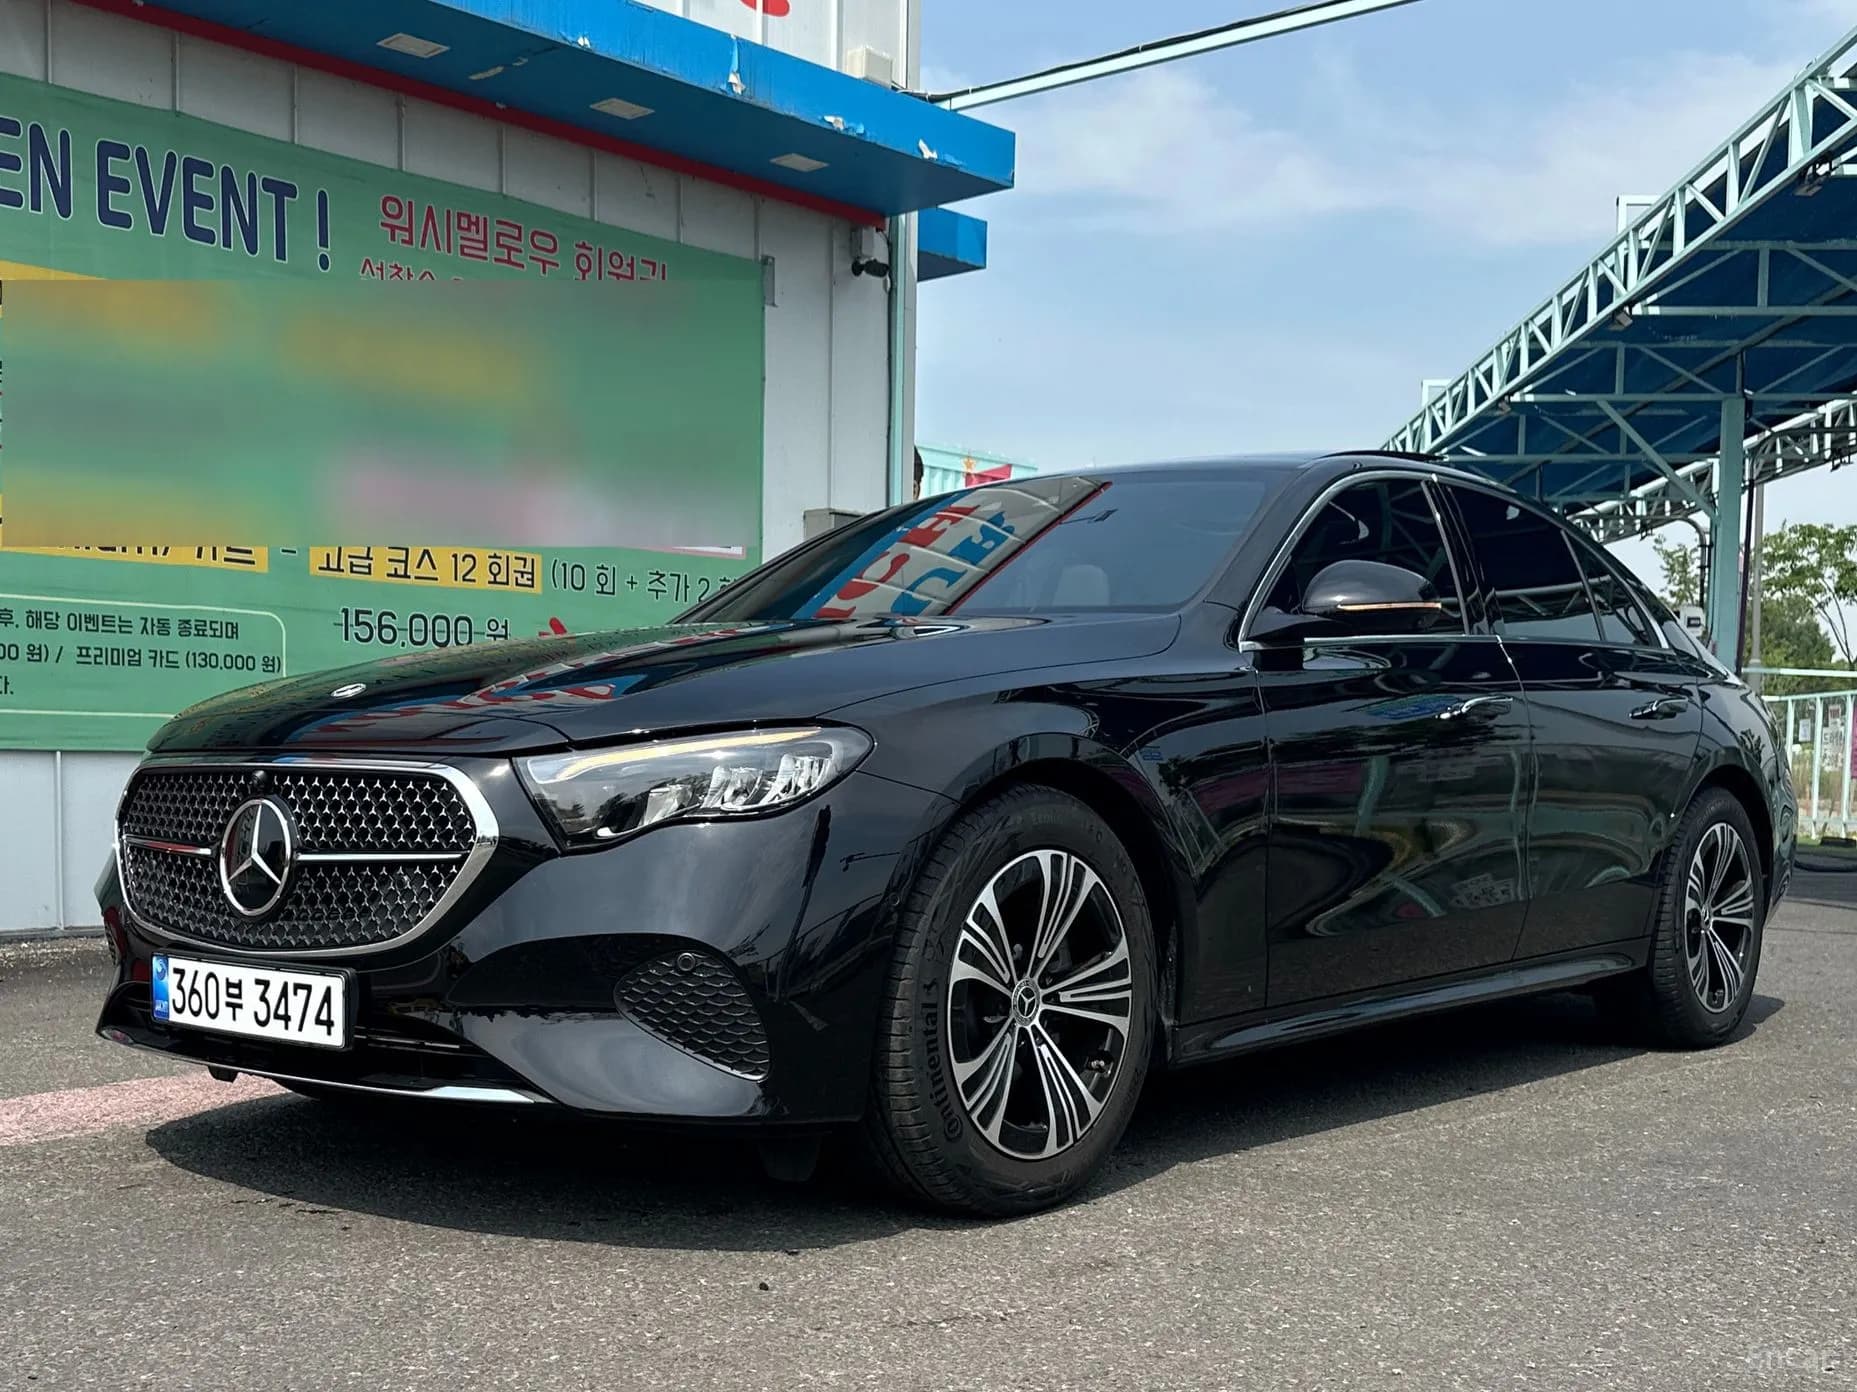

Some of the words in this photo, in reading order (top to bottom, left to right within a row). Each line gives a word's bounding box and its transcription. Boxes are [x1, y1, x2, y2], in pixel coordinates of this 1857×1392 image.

[96, 138, 298, 263] EVENT
[379, 194, 560, 276] 워시멜로우
[318, 546, 374, 577] 고급
[386, 546, 439, 582] 코스
[451, 552, 477, 583] 12
[487, 552, 536, 589] 회권
[551, 558, 587, 592] (10
[595, 563, 617, 597] 회
[647, 569, 691, 604] 추가
[25, 608, 61, 632] 해당
[66, 611, 134, 636] 이벤트는
[140, 616, 171, 637] 자동
[177, 618, 239, 641] 종료되며
[76, 645, 142, 668] 프리미엄
[148, 649, 180, 669] 카드
[172, 966, 244, 1022] 360부
[253, 978, 335, 1037] 3474
